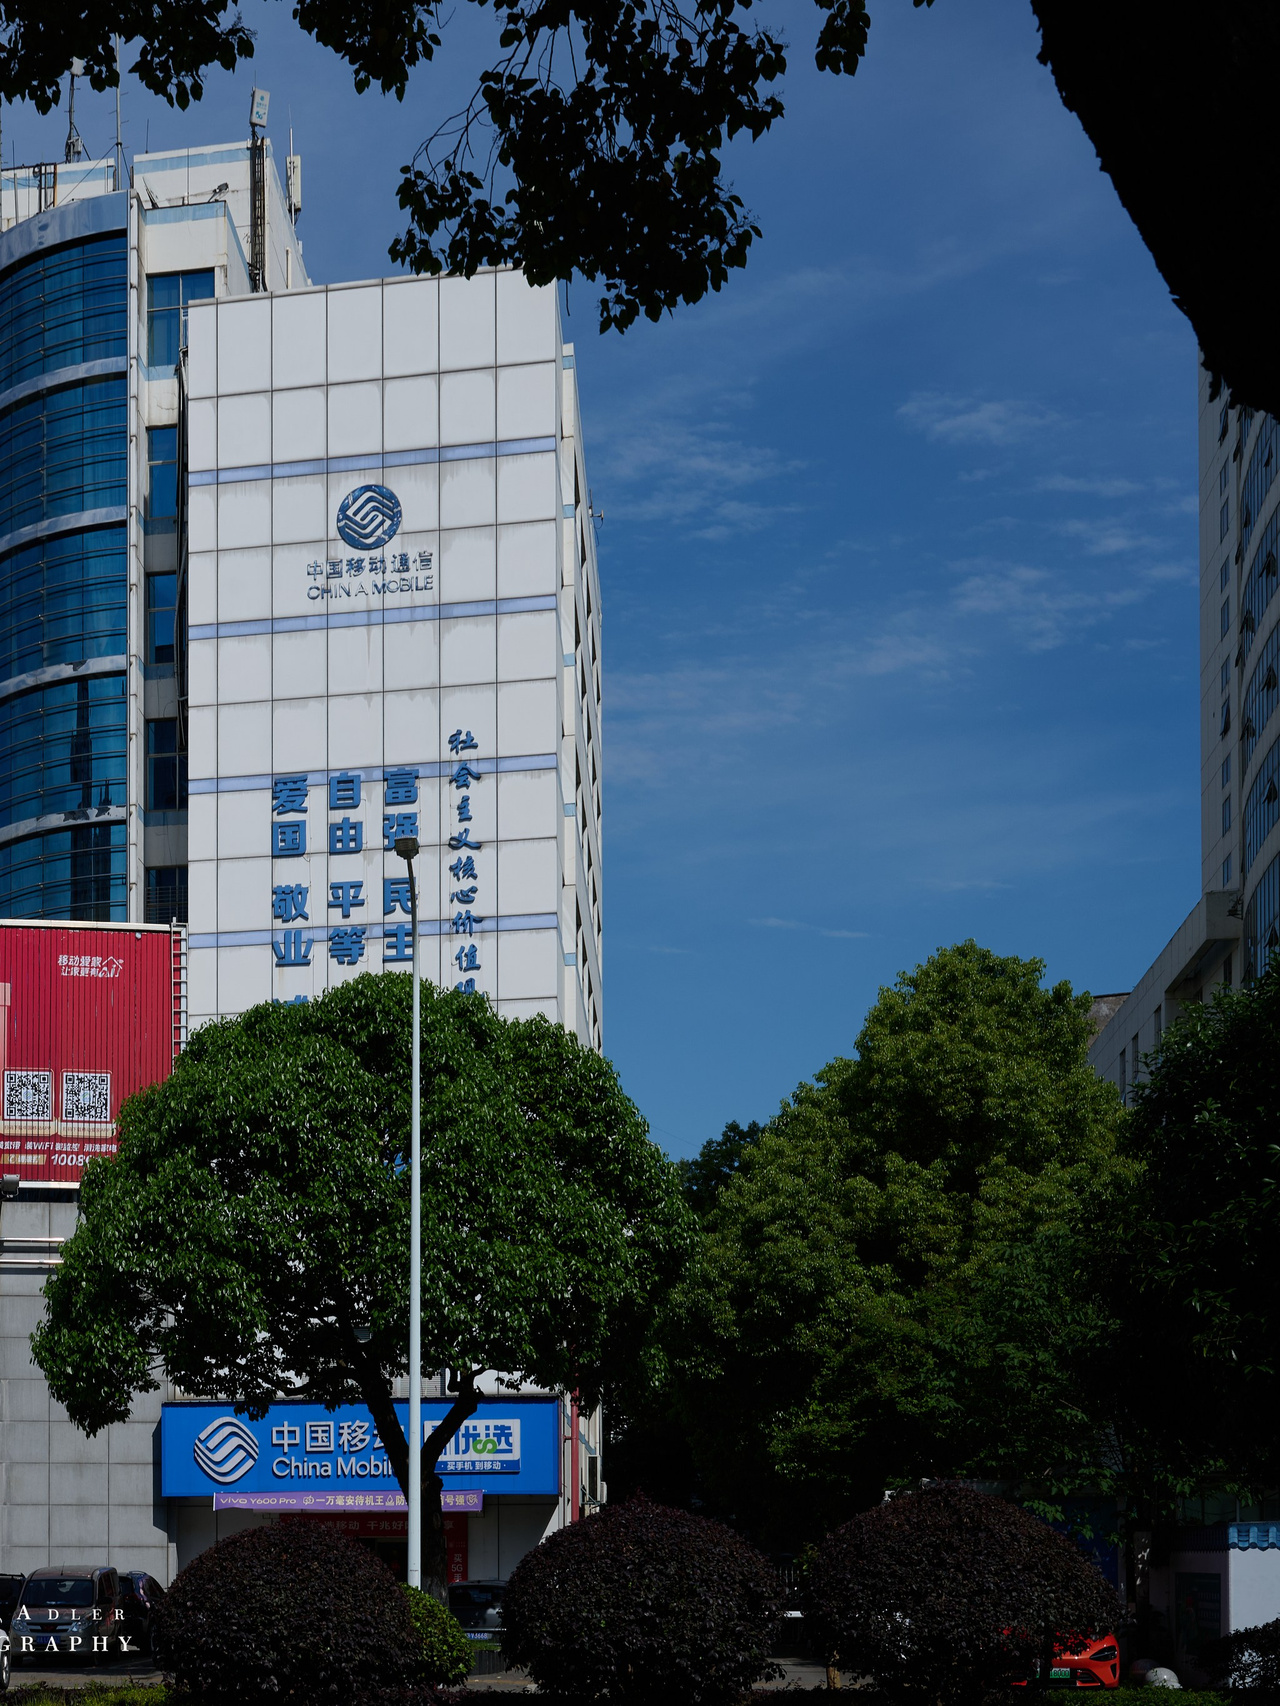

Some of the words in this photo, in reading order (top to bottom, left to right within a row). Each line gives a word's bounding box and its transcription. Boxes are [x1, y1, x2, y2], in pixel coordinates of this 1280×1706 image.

[307, 551, 433, 581] 中国移动通信
[307, 581, 368, 600] CHINA
[372, 575, 434, 595] MOBILE
[272, 775, 308, 856] 爱国
[329, 772, 363, 855] 自由
[272, 884, 313, 967] 敬业
[329, 881, 368, 964] 平等
[272, 1456, 332, 1477] China
[337, 1455, 394, 1477] Mobil
[447, 1461, 473, 1471] 买手机
[475, 1461, 502, 1471] 到移动
[250, 1497, 276, 1505] Y600
[315, 1494, 385, 1506] 一万毫安待机王
